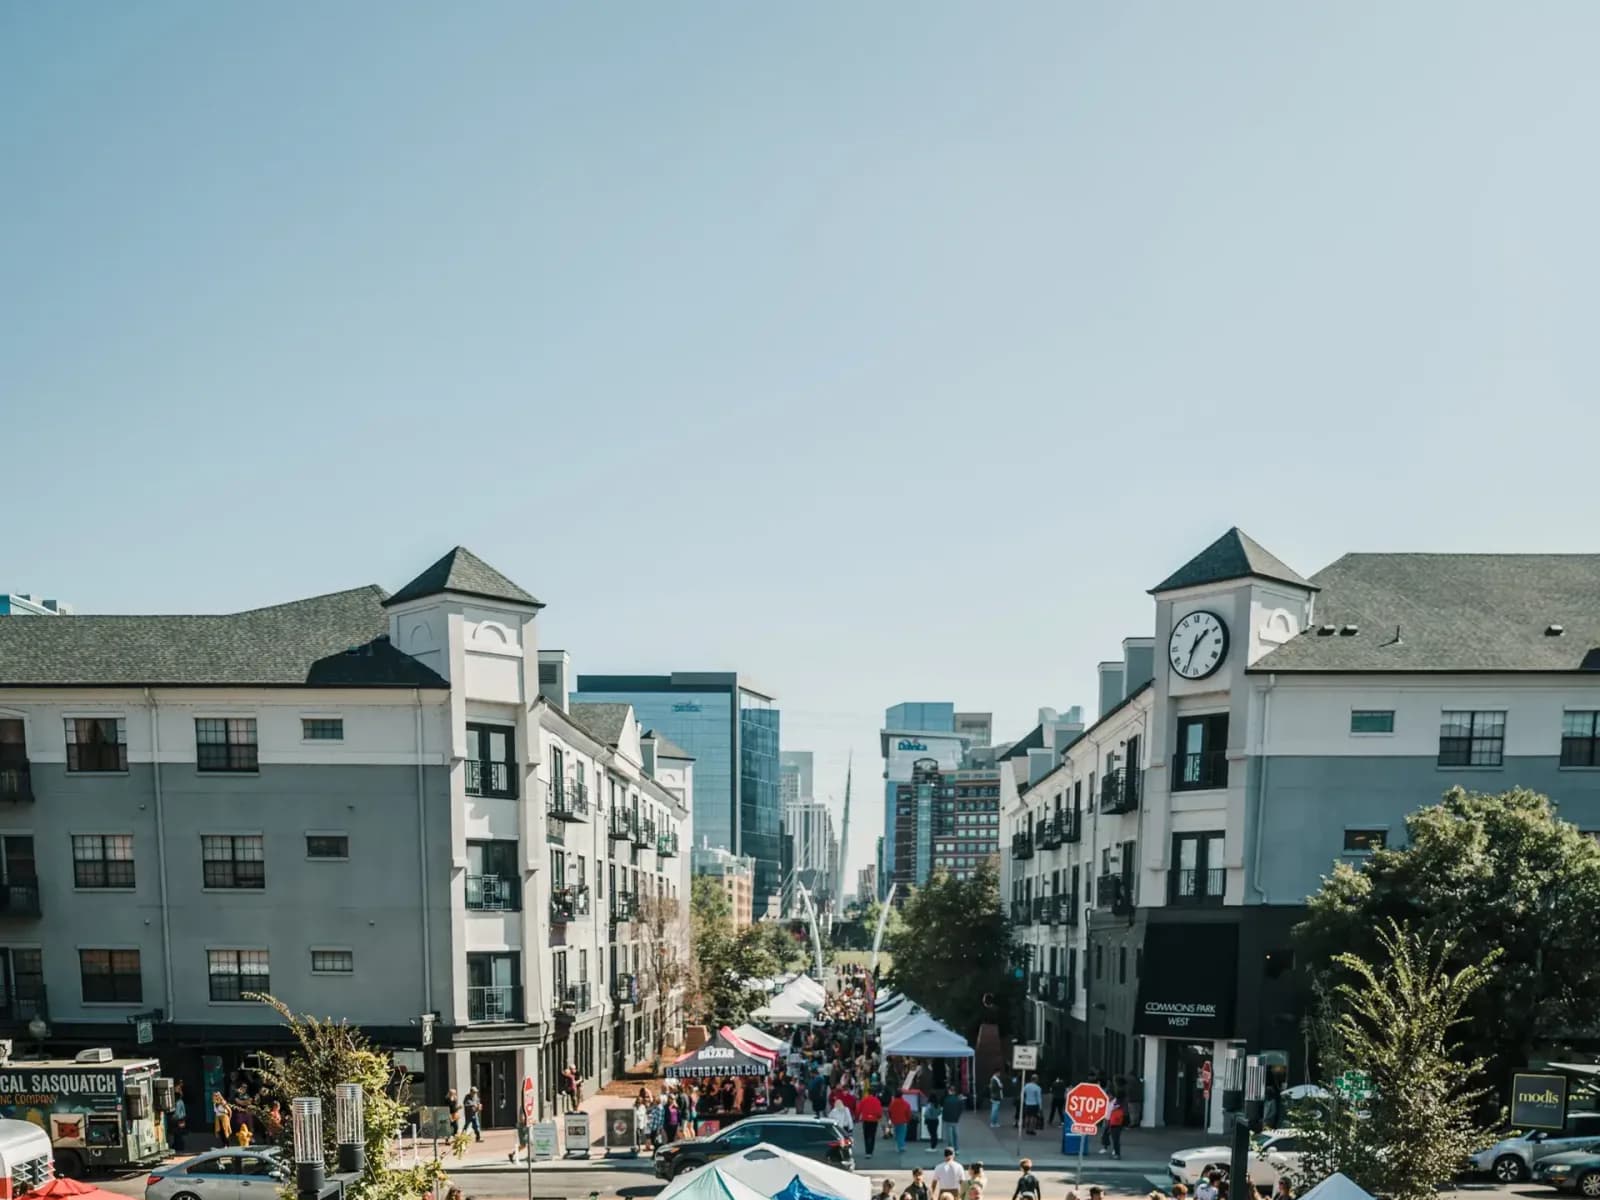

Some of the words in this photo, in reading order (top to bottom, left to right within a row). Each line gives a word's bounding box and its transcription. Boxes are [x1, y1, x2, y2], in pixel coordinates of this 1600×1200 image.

[1145, 1002, 1195, 1012] COMMONS
[1196, 1004, 1216, 1013] PARK
[1168, 1017, 1190, 1026] WEST
[665, 1065, 766, 1078] DENVERBAZAAR.COM
[32, 1074, 116, 1095] SASQUATCH
[15, 1094, 58, 1105] COMPANY
[1069, 1096, 1106, 1114] STOP
